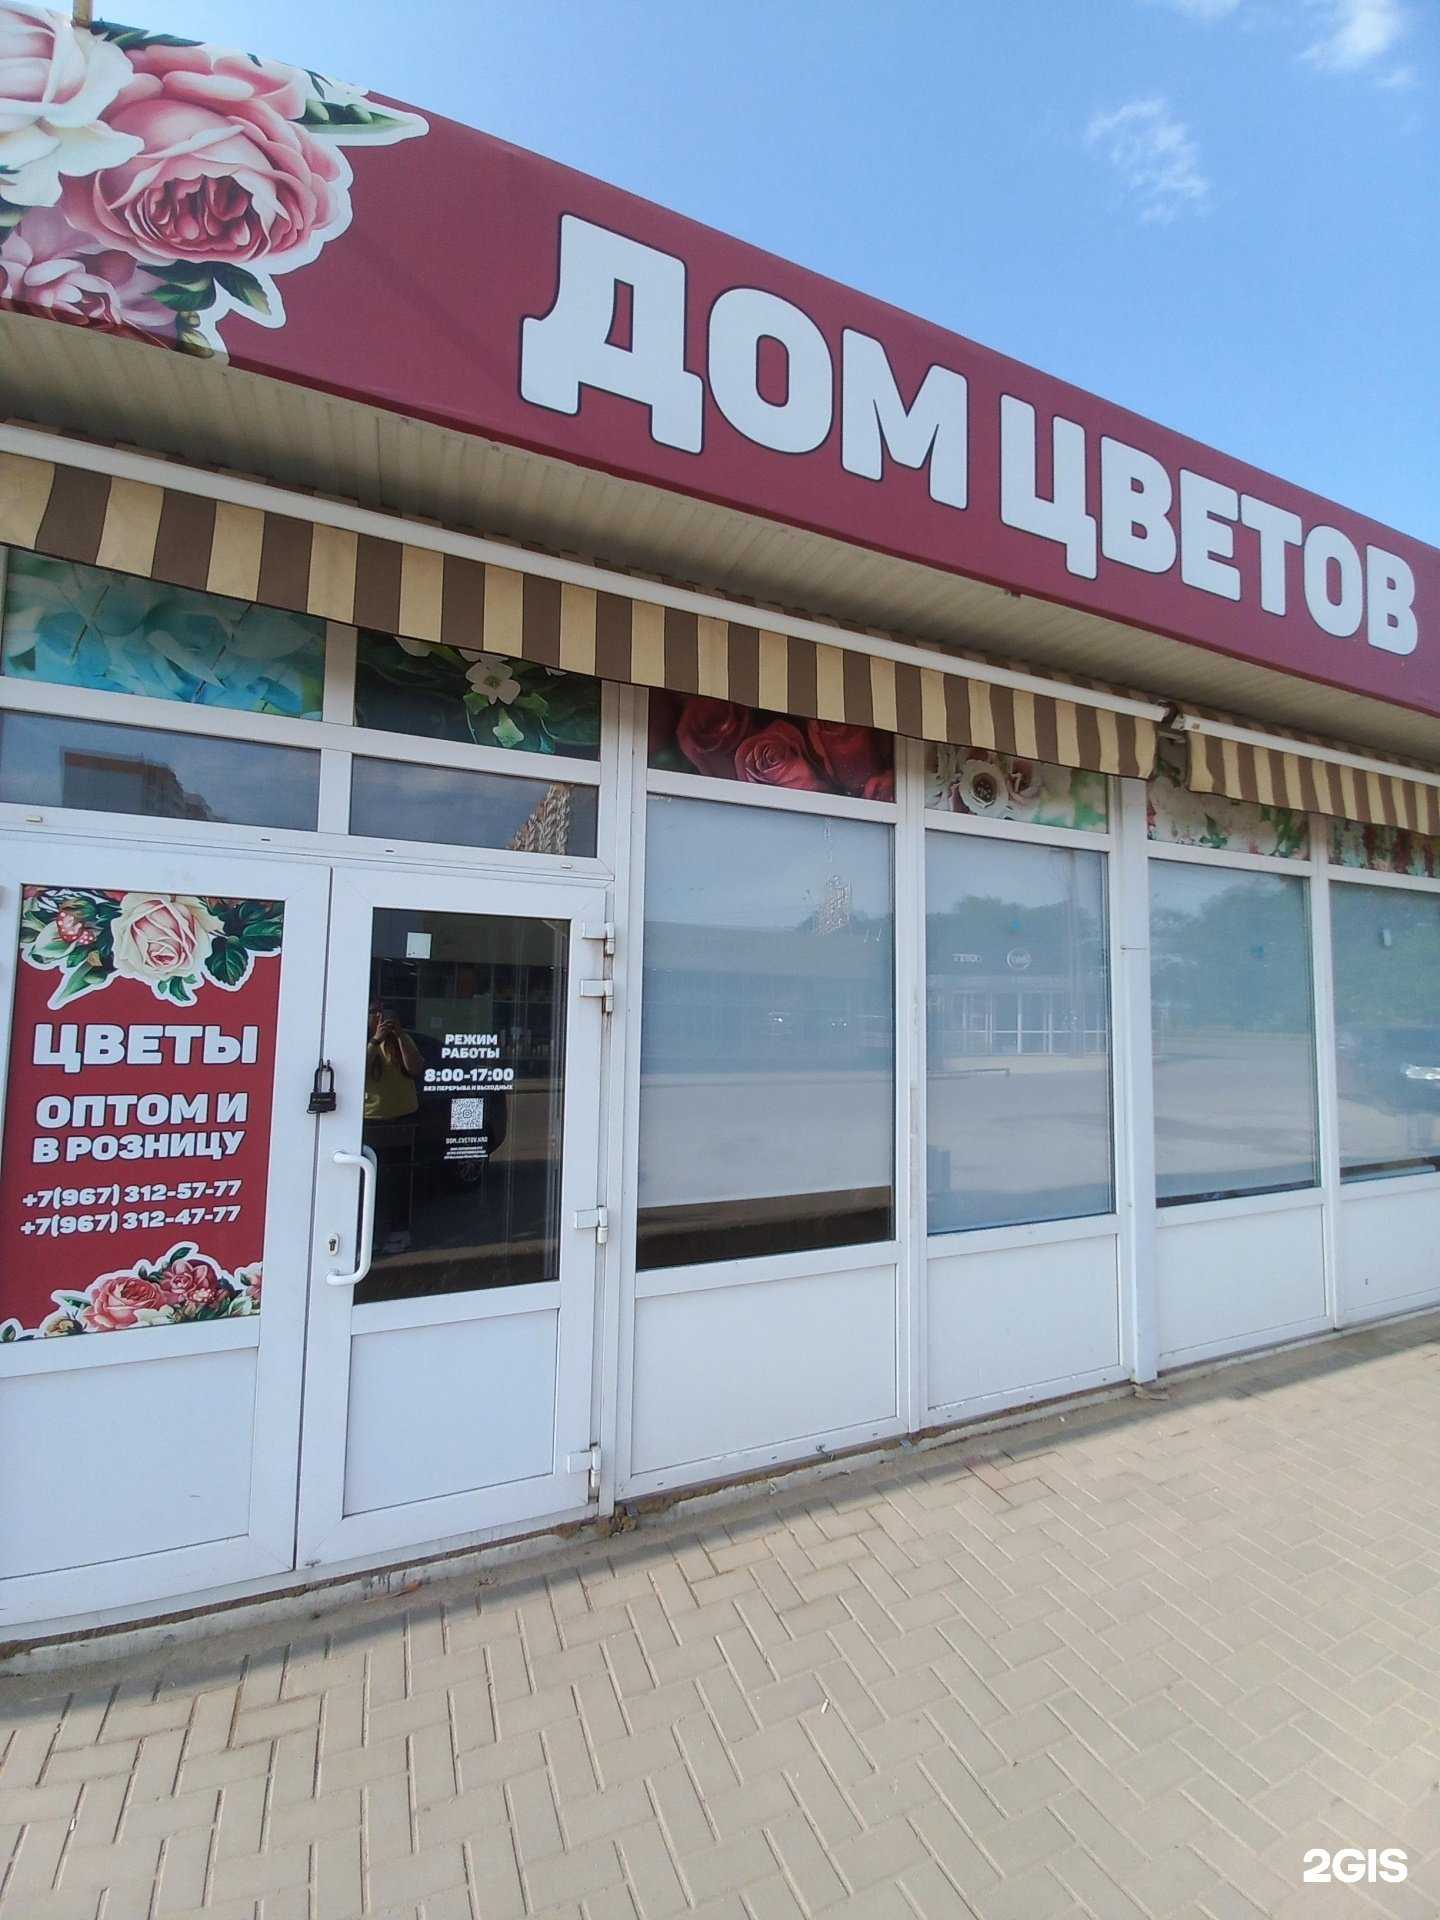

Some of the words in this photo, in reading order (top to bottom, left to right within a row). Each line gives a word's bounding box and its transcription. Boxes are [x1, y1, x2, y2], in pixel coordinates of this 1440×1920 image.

[519, 212, 967, 511] ДОМ
[1000, 393, 1419, 656] ЦВЕТОВ
[32, 1023, 260, 1073] ЦВЕТЫ
[441, 1047, 500, 1059] РАБОТЫ
[444, 1034, 498, 1046] РЕЖИМ
[424, 1068, 514, 1082] 8:00-17:00
[36, 1093, 208, 1129] ОПТОМ
[217, 1093, 249, 1123] И
[32, 1136, 60, 1164] В
[65, 1130, 246, 1162] РОЗНИЦУ
[22, 1183, 119, 1210] +7(967)
[124, 1179, 242, 1203] 312-57-77
[20, 1210, 118, 1238] +7(967)
[122, 1205, 241, 1230] 312-47-77
